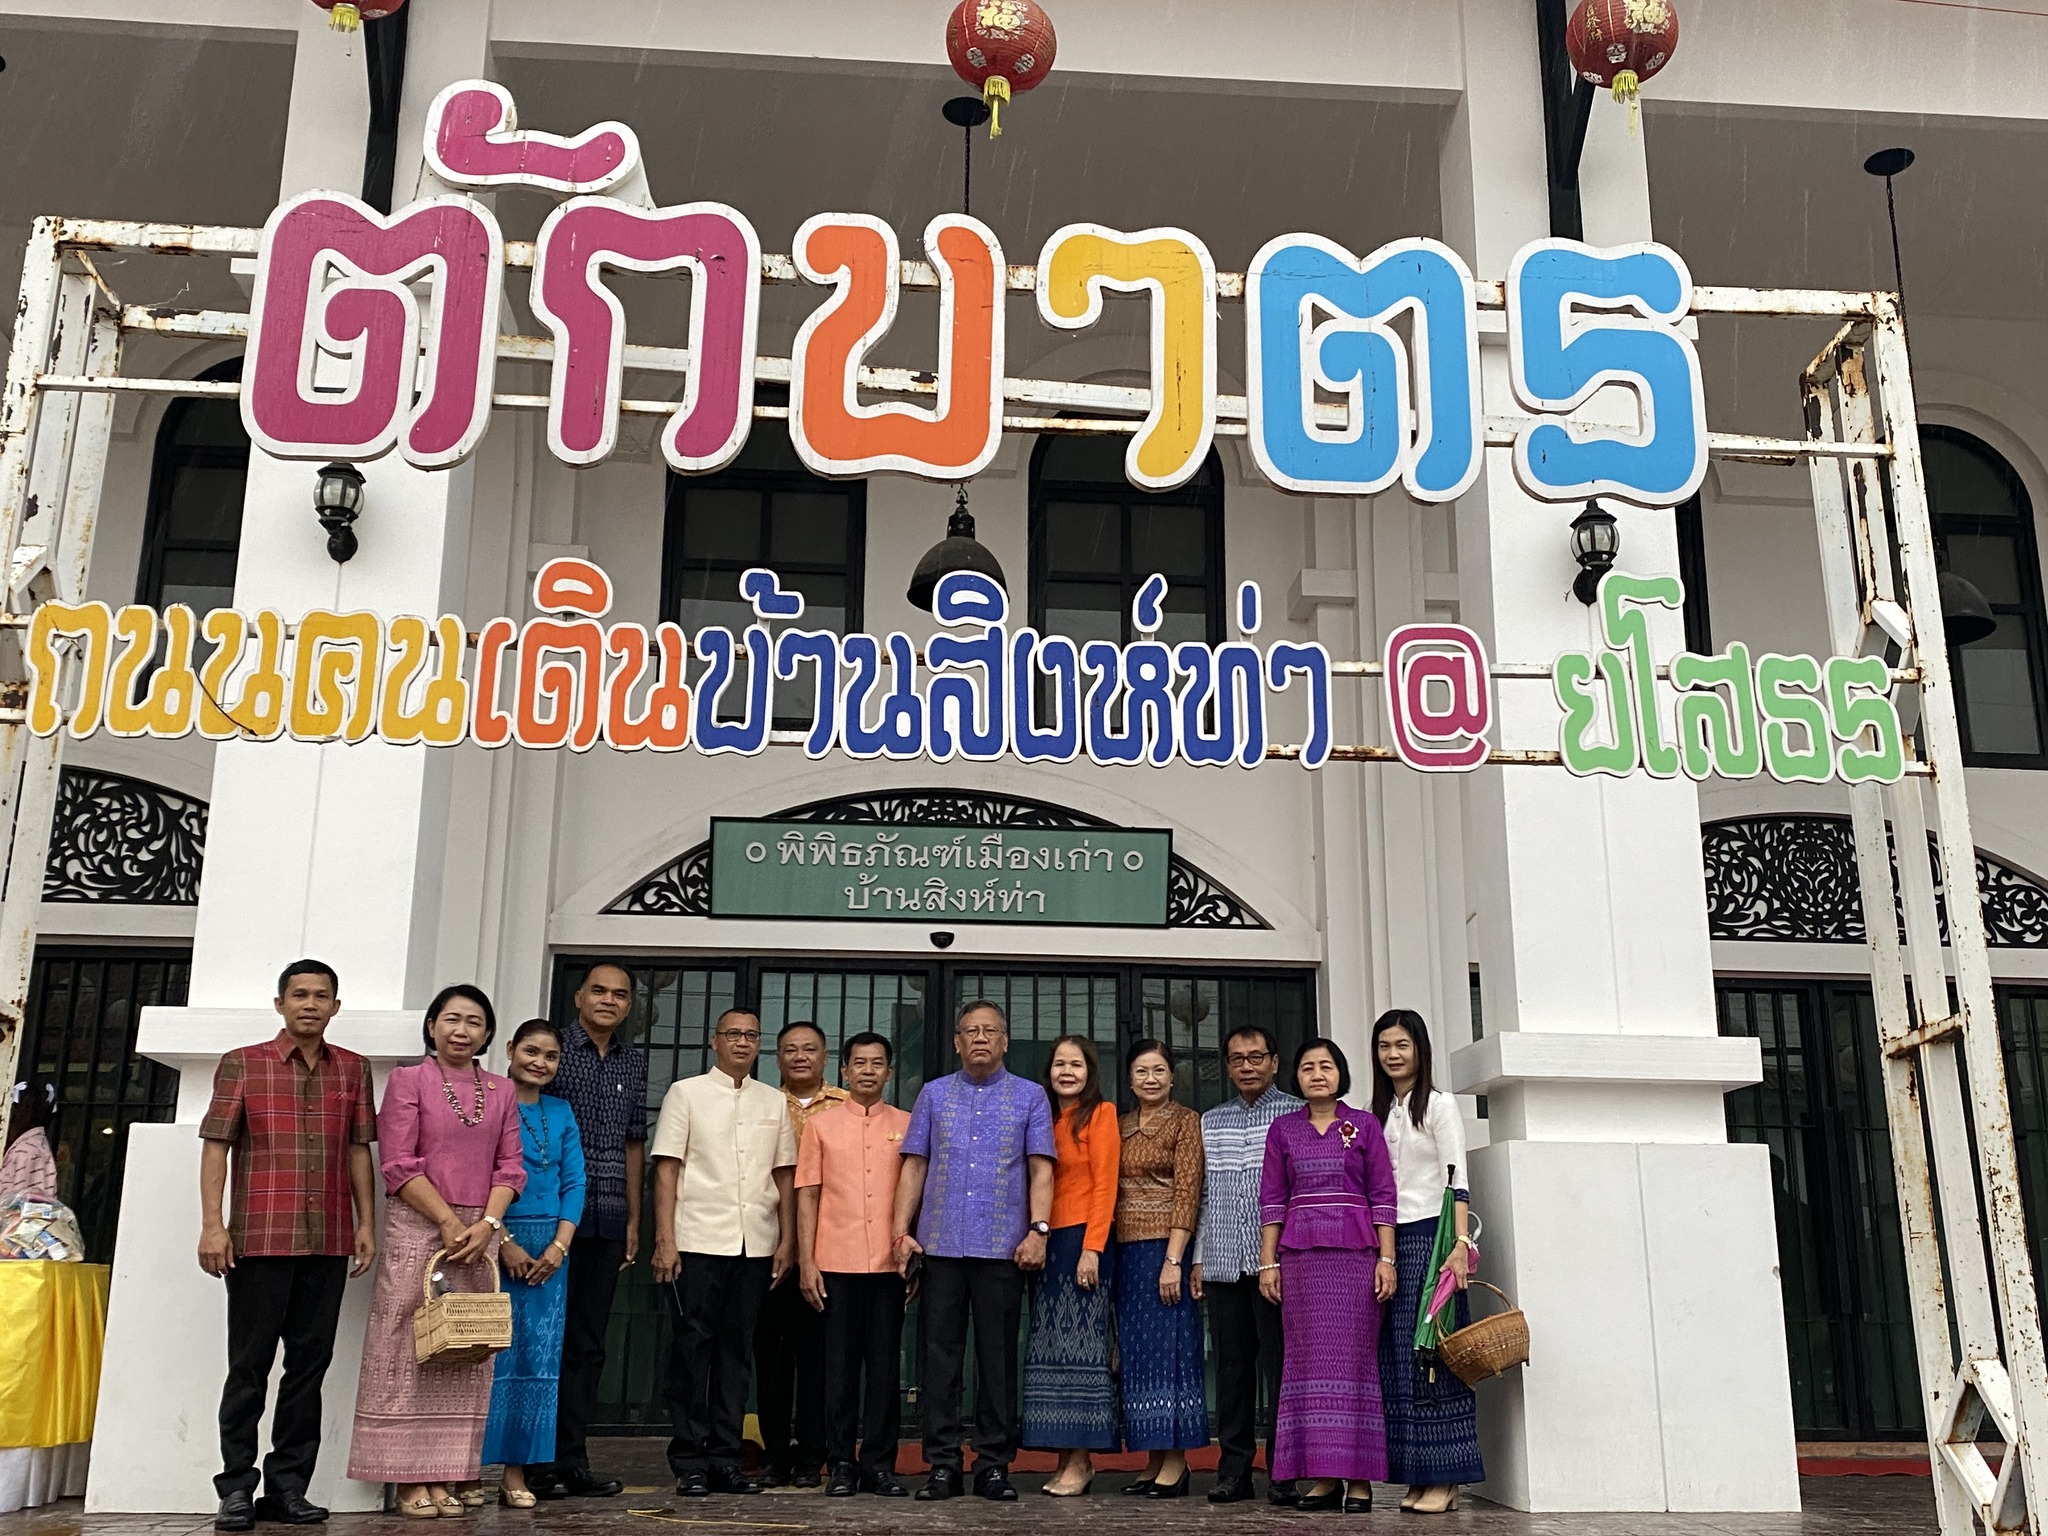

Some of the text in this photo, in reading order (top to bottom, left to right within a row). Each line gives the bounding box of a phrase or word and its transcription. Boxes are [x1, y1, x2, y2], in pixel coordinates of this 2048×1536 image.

[241, 79, 1707, 507] ตักบาตร
[1384, 623, 1492, 773] @
[1553, 571, 1906, 784] ยโสธร
[777, 830, 1113, 872] พิพิธภัณฑ์เมืองเก่า
[844, 872, 1046, 913] บ้านสิงห์ท่า
